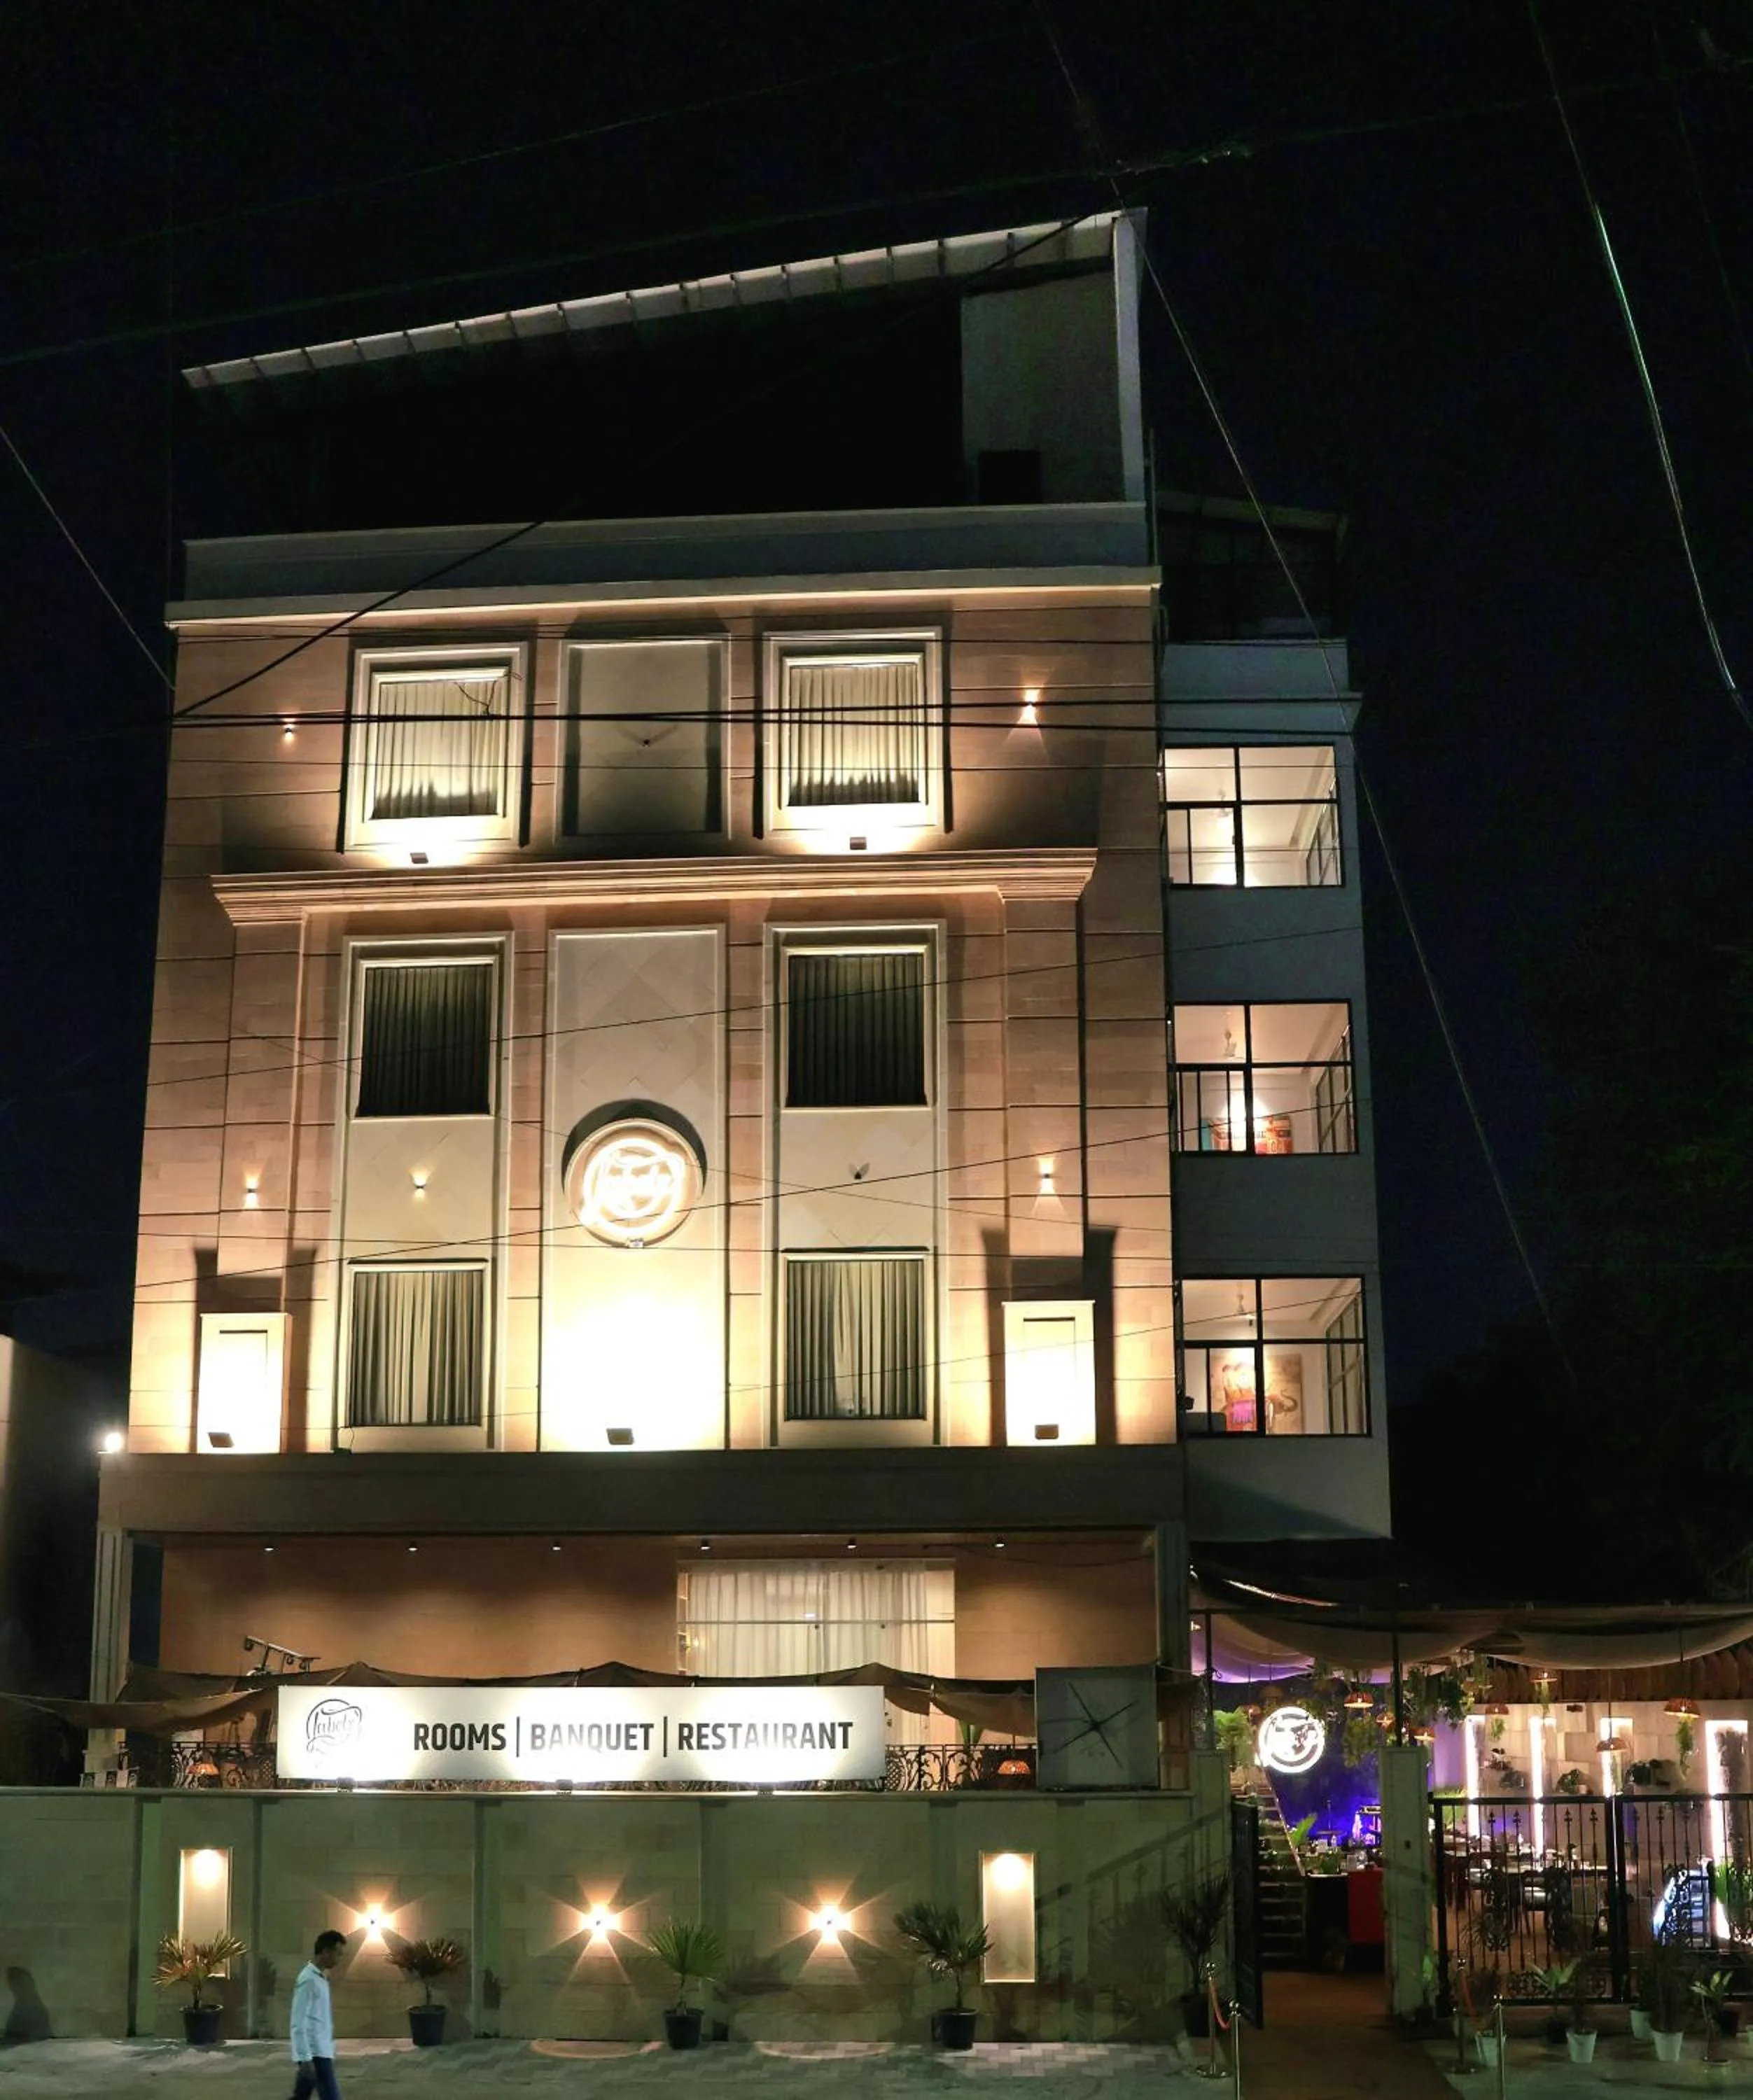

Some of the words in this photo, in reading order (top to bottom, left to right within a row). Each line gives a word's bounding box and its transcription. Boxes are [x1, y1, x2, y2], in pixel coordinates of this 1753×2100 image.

[414, 1723, 507, 1751] ROOMS
[530, 1723, 655, 1753] BANQUET
[678, 1721, 853, 1751] RESTAURANT
